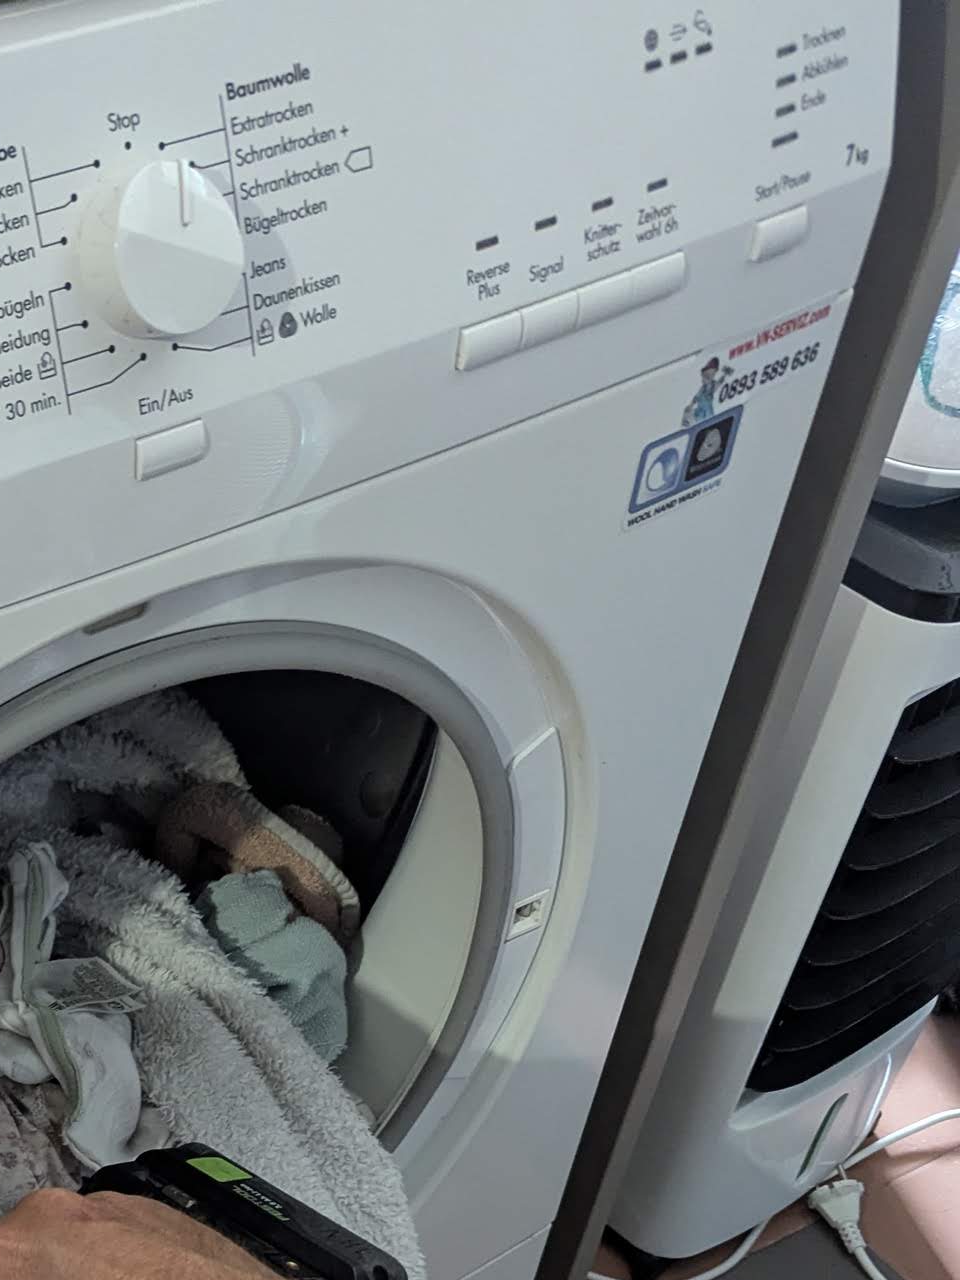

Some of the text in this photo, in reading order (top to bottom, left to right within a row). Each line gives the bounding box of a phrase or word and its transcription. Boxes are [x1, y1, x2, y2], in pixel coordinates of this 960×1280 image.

[225, 62, 311, 101] Baumwolle
[801, 89, 826, 111] Ende
[107, 111, 140, 132] Stop
[230, 101, 314, 136] Extratrocken
[235, 128, 337, 167] Schranktrocken
[846, 143, 869, 167] 7 kg
[240, 160, 341, 201] Schranktrocken
[755, 171, 812, 202] Start/Pause
[244, 199, 328, 235] Bügeltrocken
[636, 216, 679, 243] wahl 6h
[587, 240, 620, 262] schutz
[249, 256, 286, 280] Jeans
[466, 262, 510, 286] Reverse
[529, 255, 564, 283] Signal
[253, 271, 341, 311] Daunenkissen
[478, 282, 500, 300] Plus
[299, 305, 337, 328] Wolle
[718, 341, 820, 403] 0893 589 636
[5, 394, 62, 421] 30 min.
[138, 387, 194, 416] Ein/Aus
